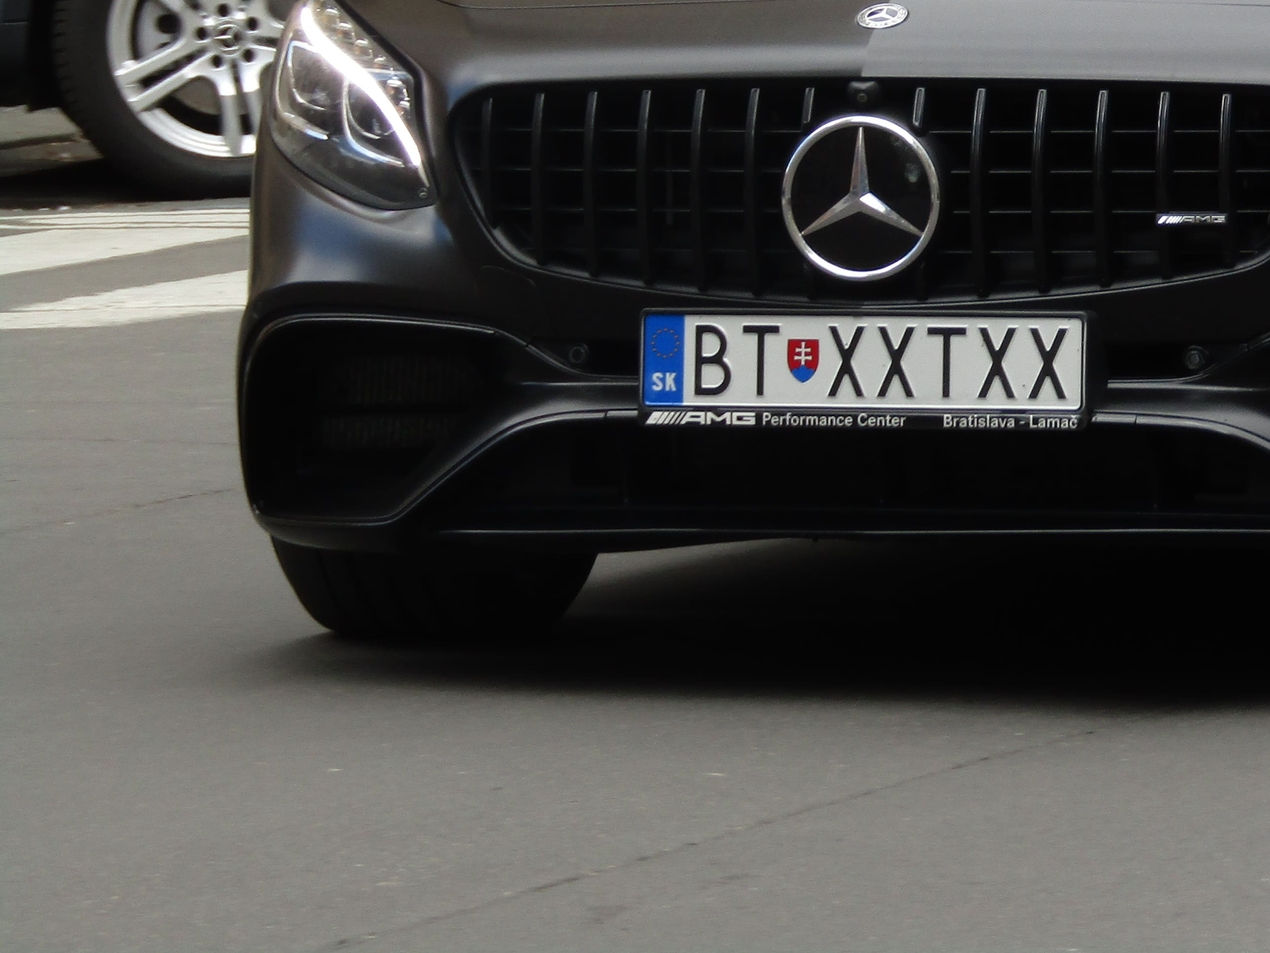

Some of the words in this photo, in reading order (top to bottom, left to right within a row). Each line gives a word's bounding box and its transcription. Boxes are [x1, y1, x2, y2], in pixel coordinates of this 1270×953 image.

[651, 372, 677, 392] SK
[762, 412, 853, 427] Performance
[857, 412, 906, 427] Center
[943, 414, 1015, 428] Bratislava
[1029, 414, 1078, 428] Lamač
